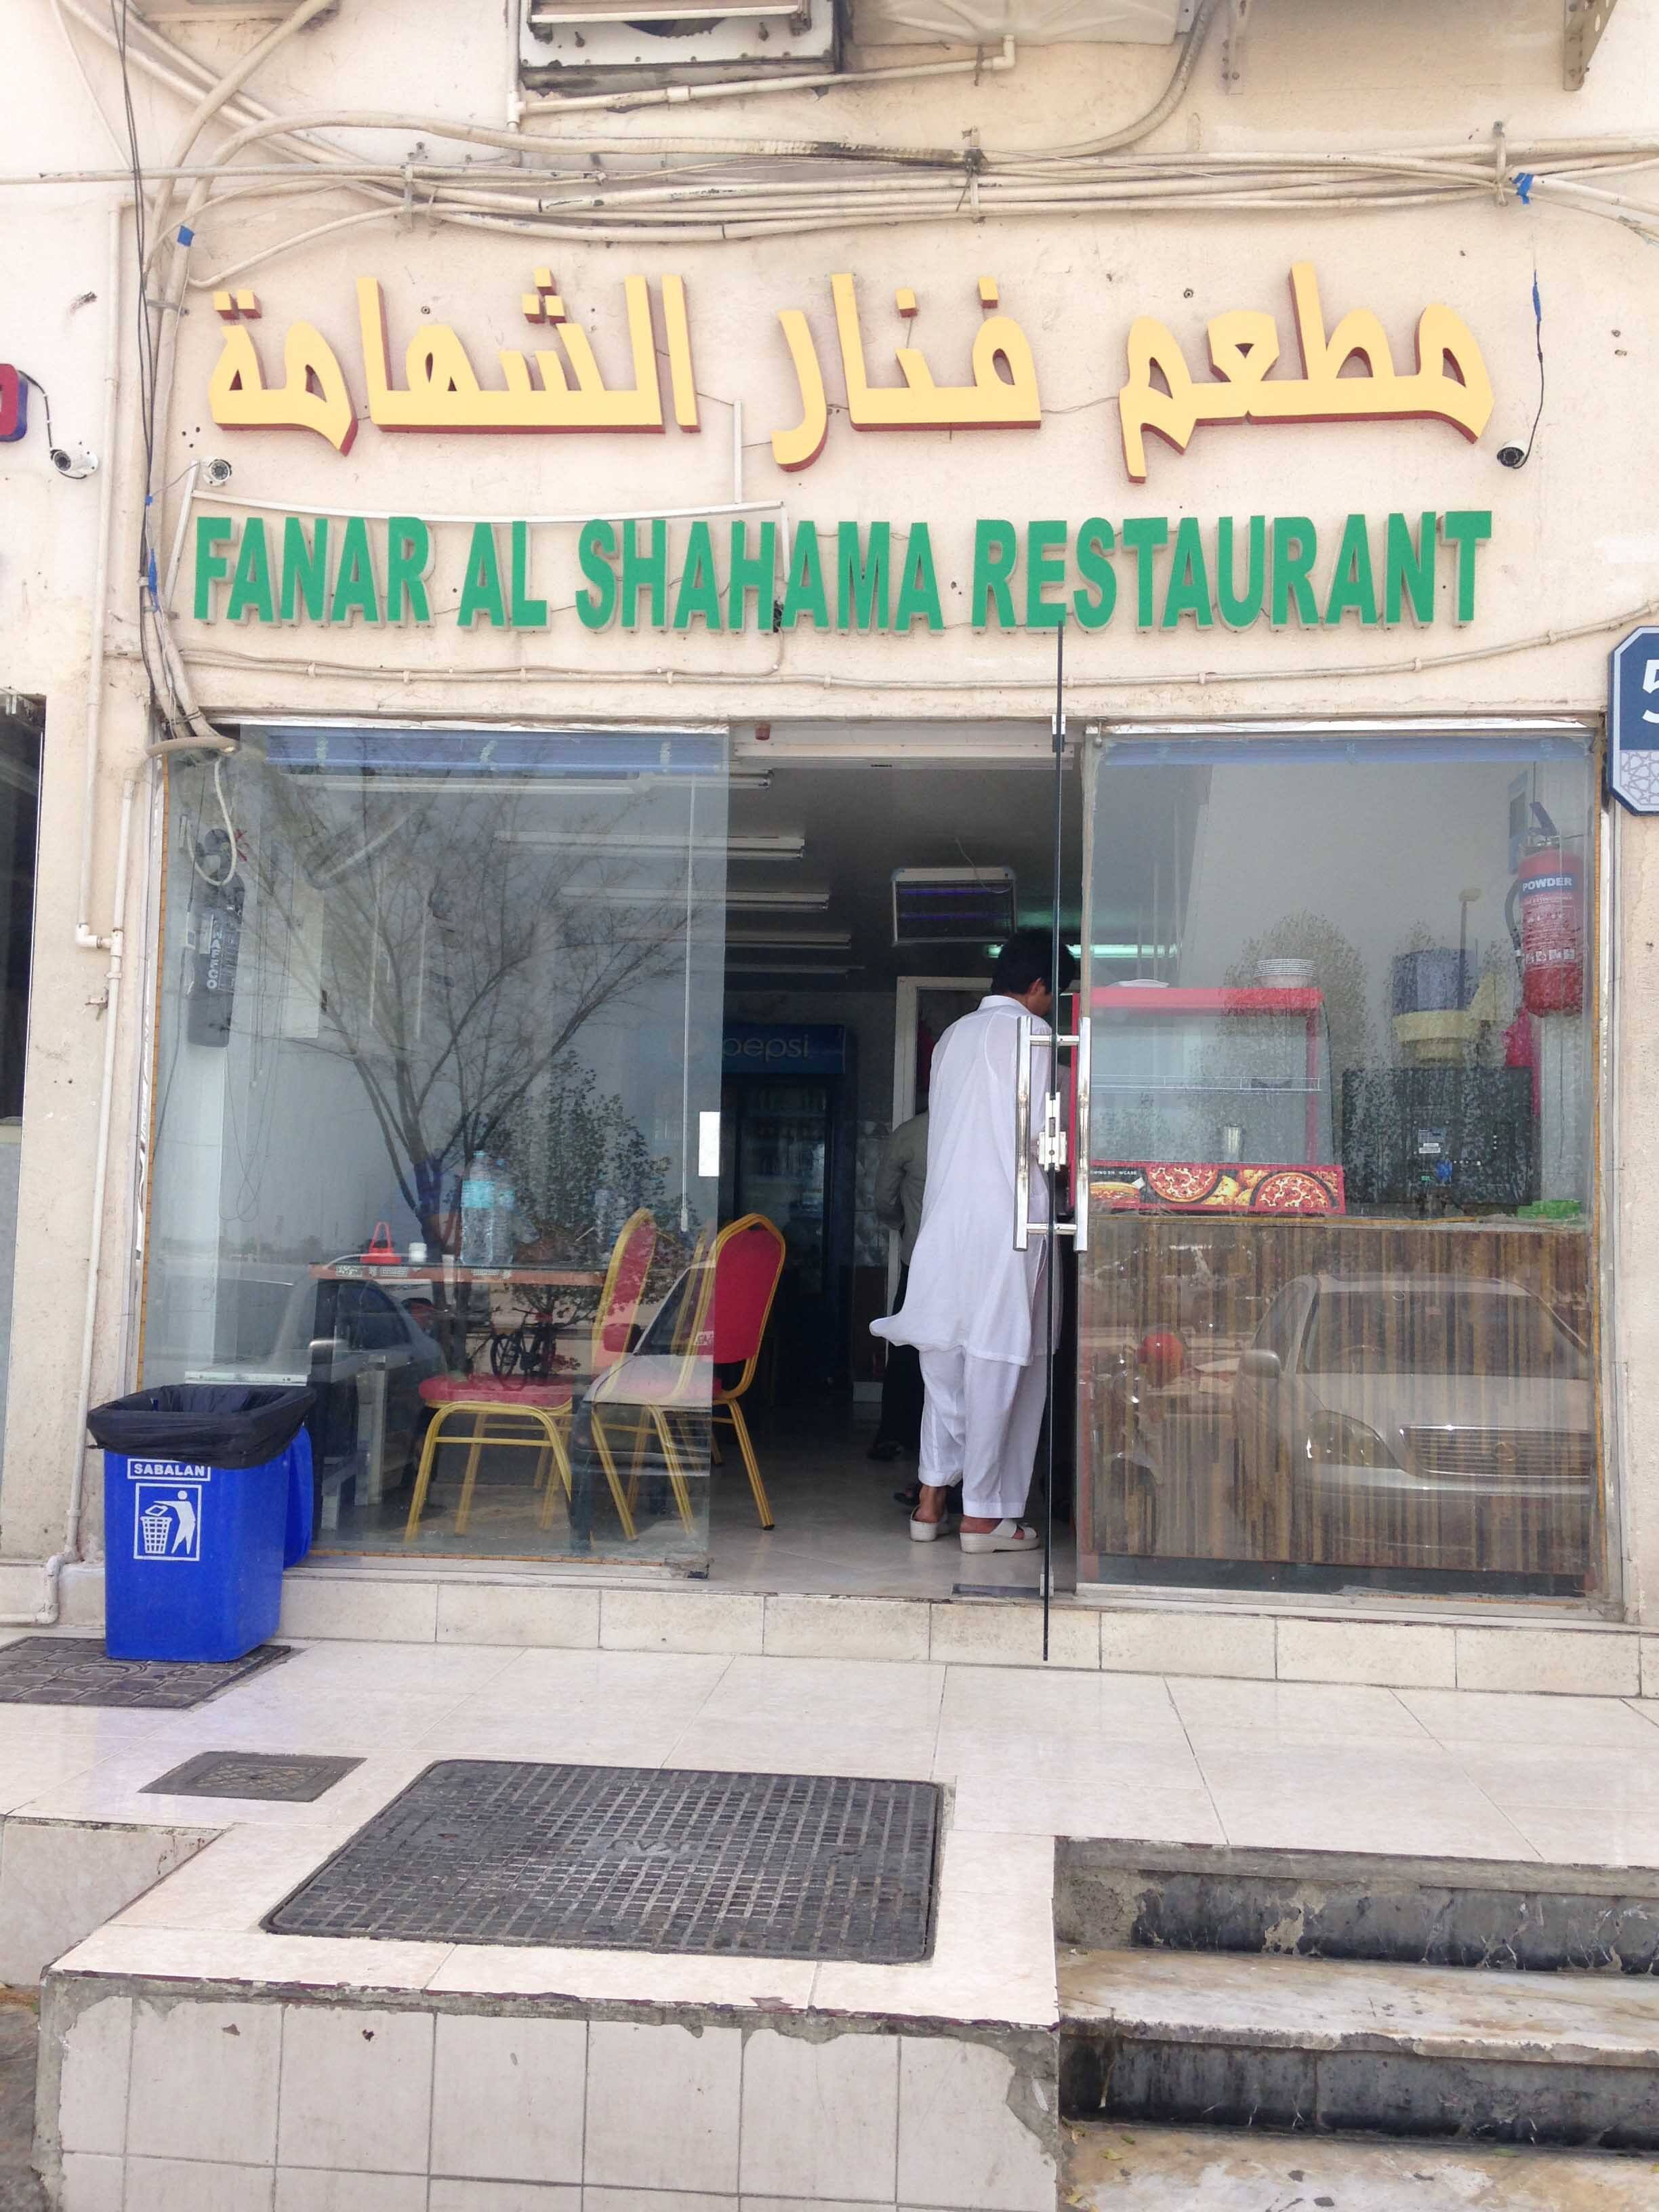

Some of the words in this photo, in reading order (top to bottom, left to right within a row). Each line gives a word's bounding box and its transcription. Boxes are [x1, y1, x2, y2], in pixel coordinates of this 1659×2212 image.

[209, 267, 699, 454] الشهامة
[771, 272, 1042, 469] فنار
[1119, 261, 1496, 483] مطعم
[194, 517, 430, 623] FANAR
[457, 521, 548, 628] AL
[576, 520, 944, 631] SHAHAMA
[972, 511, 1492, 630] RESTAURANT
[1523, 876, 1573, 892] POWDER
[134, 1463, 205, 1477] SABALAN
